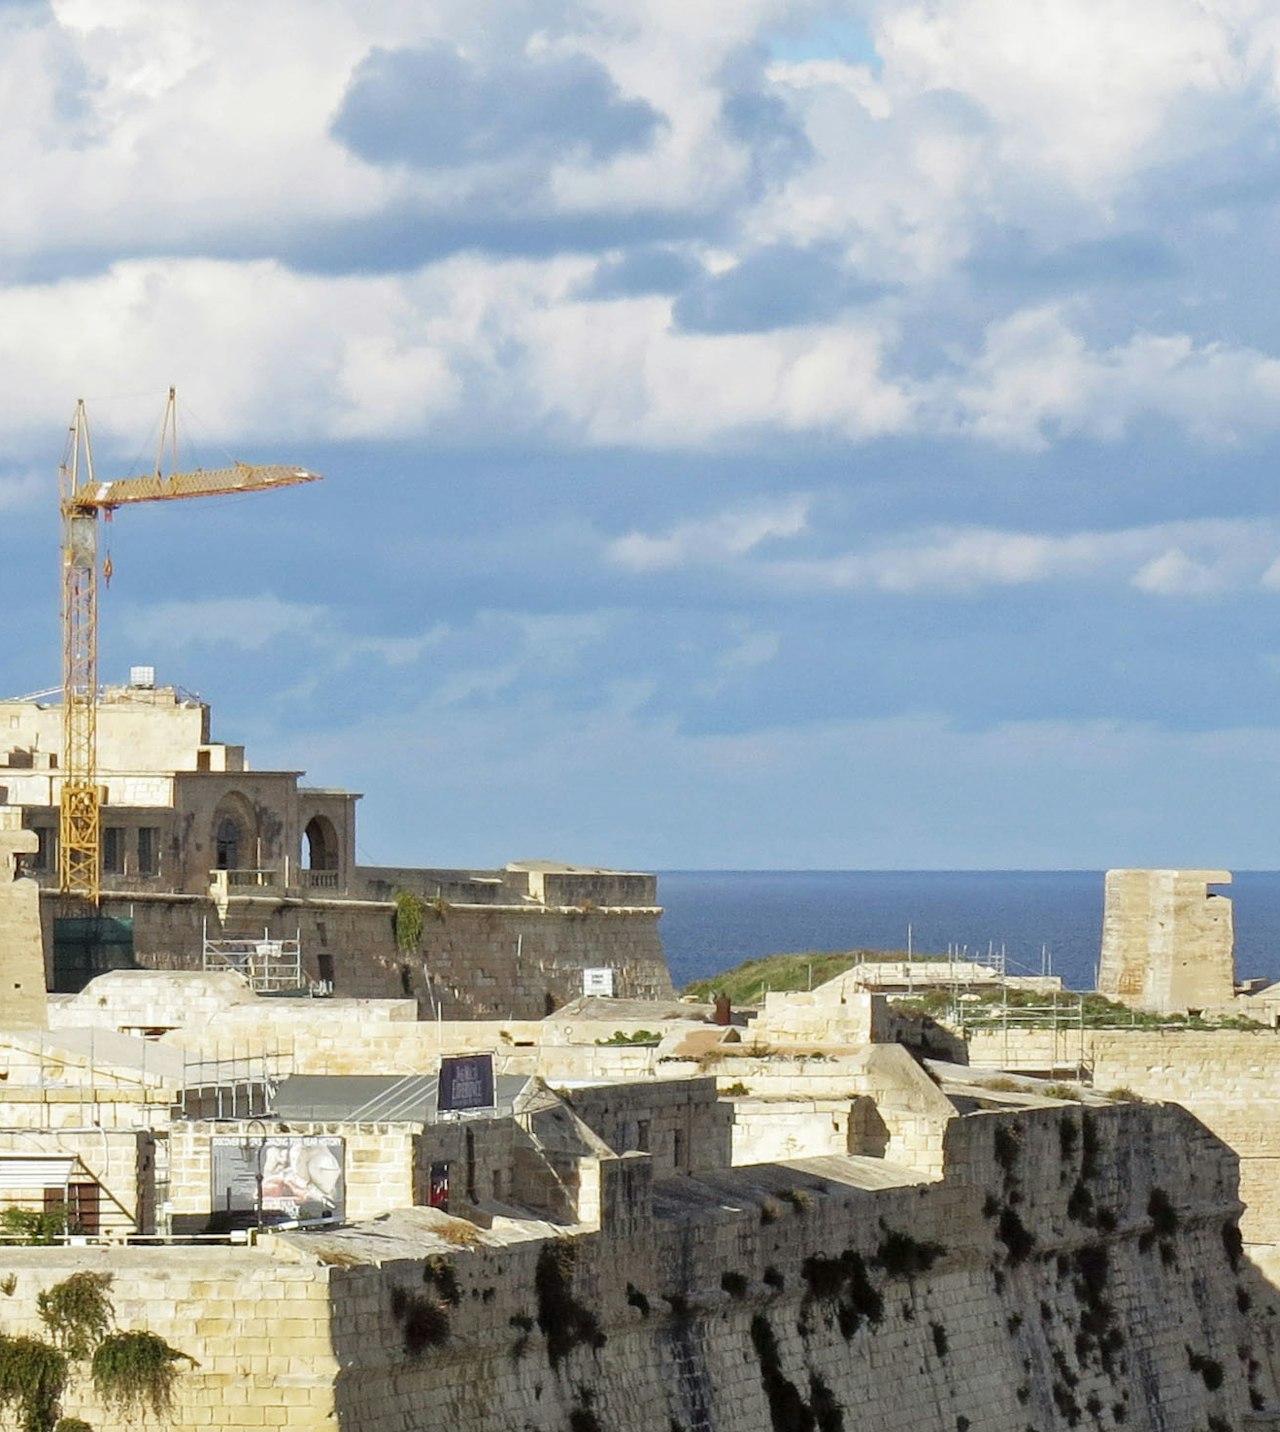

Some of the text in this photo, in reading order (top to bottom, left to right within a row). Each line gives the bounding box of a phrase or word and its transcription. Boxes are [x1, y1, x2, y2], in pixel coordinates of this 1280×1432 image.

[213, 1137, 239, 1146] DISCOVER
[303, 1137, 317, 1146] YEAR
[318, 1137, 342, 1146] HISTORY
